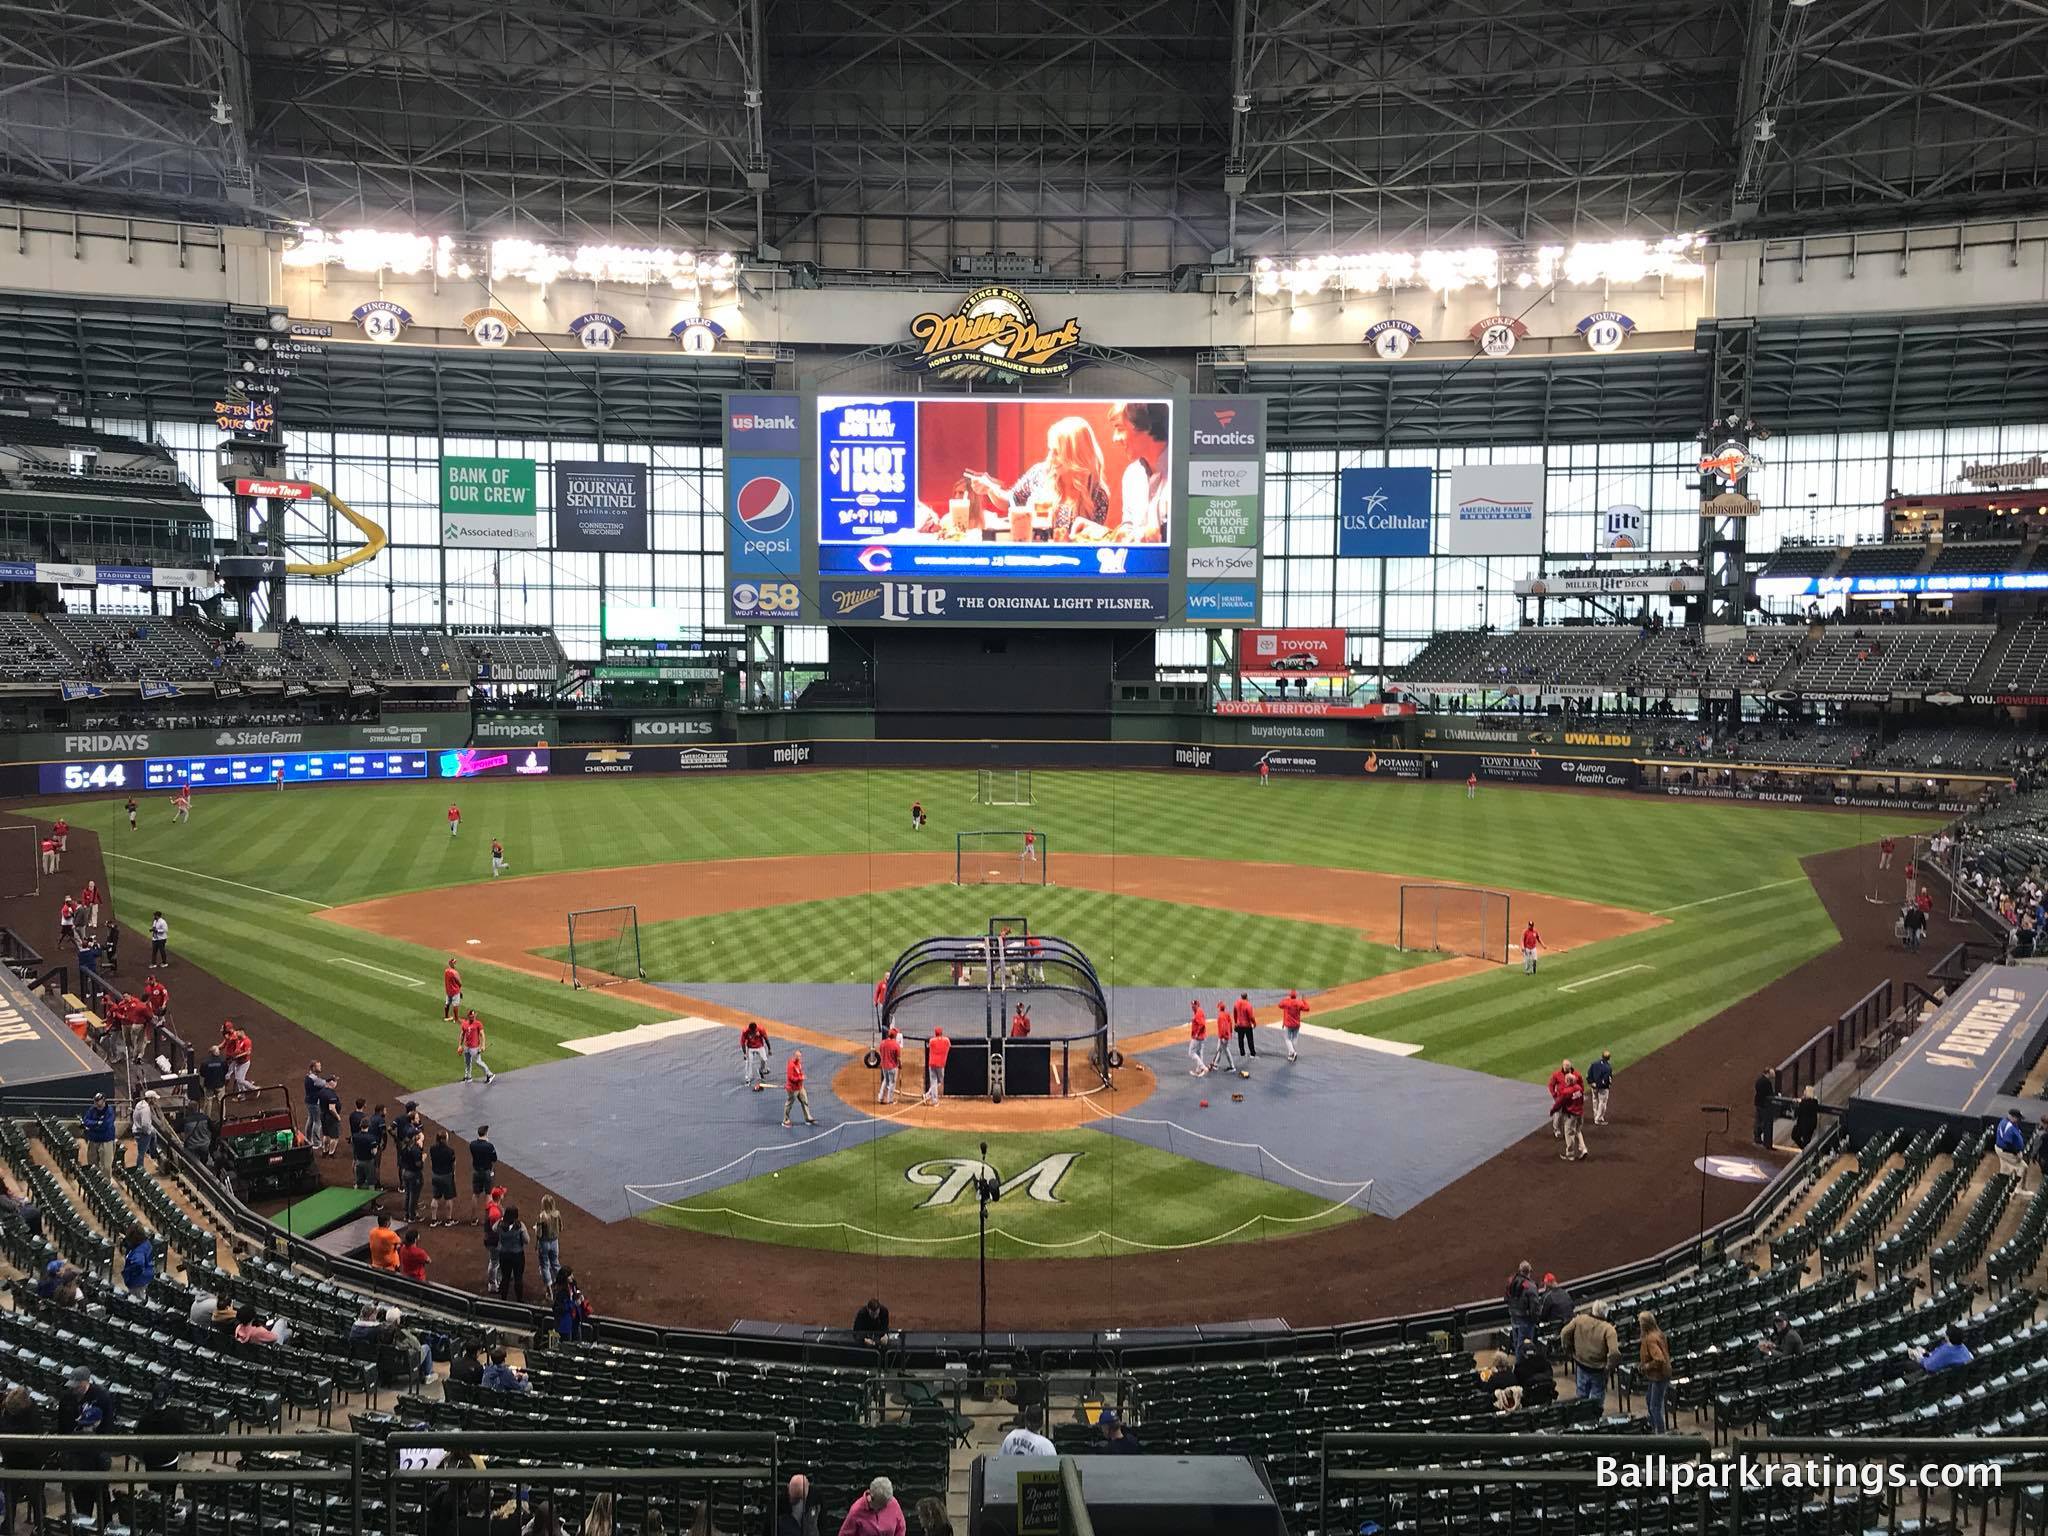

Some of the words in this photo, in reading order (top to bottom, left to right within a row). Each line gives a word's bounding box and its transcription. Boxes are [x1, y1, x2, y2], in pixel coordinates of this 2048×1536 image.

[969, 289, 999, 305] SINCE
[1001, 288, 1022, 305] 2001
[361, 301, 403, 316] FINGERS
[583, 314, 613, 325] AARON
[685, 318, 711, 328] SELIG
[1590, 313, 1621, 324] YOUNT
[291, 324, 332, 337] Gone!
[369, 317, 397, 335] 34
[478, 323, 505, 341] 42
[1373, 320, 1413, 334] MOLITOR
[584, 329, 609, 345] 44
[695, 334, 704, 350] 1
[912, 312, 1016, 356] Miller
[996, 317, 1081, 364] Park
[1488, 330, 1508, 344] 50
[1593, 327, 1617, 346] 19
[272, 342, 291, 351] Get
[293, 344, 322, 353] Outta
[1385, 335, 1397, 353] 4
[276, 351, 301, 360] Here
[928, 355, 951, 369] HOME
[951, 353, 963, 361] OF
[965, 352, 981, 361] THE
[982, 354, 1029, 374] MILWAUKEE
[1030, 363, 1069, 375] BREWERS
[258, 367, 276, 375] Get
[277, 368, 291, 377] Up
[247, 383, 265, 392] Get
[266, 385, 280, 393] Up
[213, 400, 274, 419] BERNIE'S
[216, 416, 273, 432] DUGOUT
[1194, 430, 1255, 445] Fanatics
[852, 447, 907, 473] HOT
[449, 467, 488, 484] BANK
[491, 468, 510, 484] OF
[1201, 468, 1236, 478] metro
[1956, 457, 2048, 482] Johnsonville
[249, 483, 279, 495] KWIK
[278, 485, 302, 497] TRIP
[566, 481, 636, 496] JOURNAL
[1201, 478, 1241, 488] market
[450, 485, 479, 502] OUR
[566, 494, 636, 508] SENTINEL
[1210, 500, 1238, 509] SHOP
[575, 508, 628, 516] jsonline.com
[1205, 509, 1242, 518] ONLINE
[1701, 502, 1758, 515] Johnsonville
[1197, 518, 1219, 526] FOR
[1220, 518, 1249, 526] MORE
[1343, 515, 1368, 530] U.S.
[1368, 515, 1428, 530] Cellular
[1607, 513, 1640, 533] Lite
[1200, 526, 1246, 535] TAILGATE
[744, 538, 791, 555] pepsi
[1210, 535, 1236, 544] TIME!
[1192, 558, 1214, 568] Pick
[1225, 559, 1254, 568] Save
[1565, 581, 1598, 589] MILLER
[1600, 577, 1623, 592] Lite
[759, 583, 800, 610] 58
[832, 588, 882, 614] Miller
[880, 582, 946, 622] Lite
[957, 597, 984, 609] THE
[988, 597, 1050, 609] ORIGINAL
[1053, 598, 1093, 609] LIGHT
[1097, 598, 1154, 610] PILSNER.
[1189, 596, 1216, 608] WPS
[1281, 641, 1328, 650] TOYOTA
[491, 664, 513, 680] Club
[515, 664, 557, 680] Goodwill
[666, 668, 693, 678] CHECK
[693, 668, 714, 678] DECK
[1969, 695, 1996, 704] YOU.
[1219, 702, 1263, 714] TOYOTA
[1265, 702, 1328, 715] TERRITORY
[489, 722, 544, 738] impact
[634, 721, 713, 735] KOHL'S
[1251, 725, 1325, 738] buyatoyota.com
[65, 734, 149, 752] FRIDAYS
[369, 735, 401, 743] STREAMING
[1565, 732, 1632, 746] UWM.EDU
[773, 743, 810, 765] meijer
[1175, 746, 1212, 767] meijer
[1269, 757, 1292, 765] WEST
[1292, 758, 1317, 766] BEND
[1480, 757, 1511, 767] TOWN
[1513, 758, 1542, 769] BANK
[1577, 762, 1606, 773] Aurora
[65, 764, 126, 788] 5:44
[584, 765, 634, 773] CHEVROLET
[1575, 772, 1604, 783] Health
[1605, 773, 1626, 784] Care
[1682, 787, 1707, 797] Aurora
[1708, 788, 1734, 798] Health
[1735, 790, 1753, 799] Care
[1759, 792, 1802, 802] BULLPEN
[1850, 798, 1879, 808] Aurora
[1880, 799, 1911, 809] Health
[1912, 800, 1932, 810] Care
